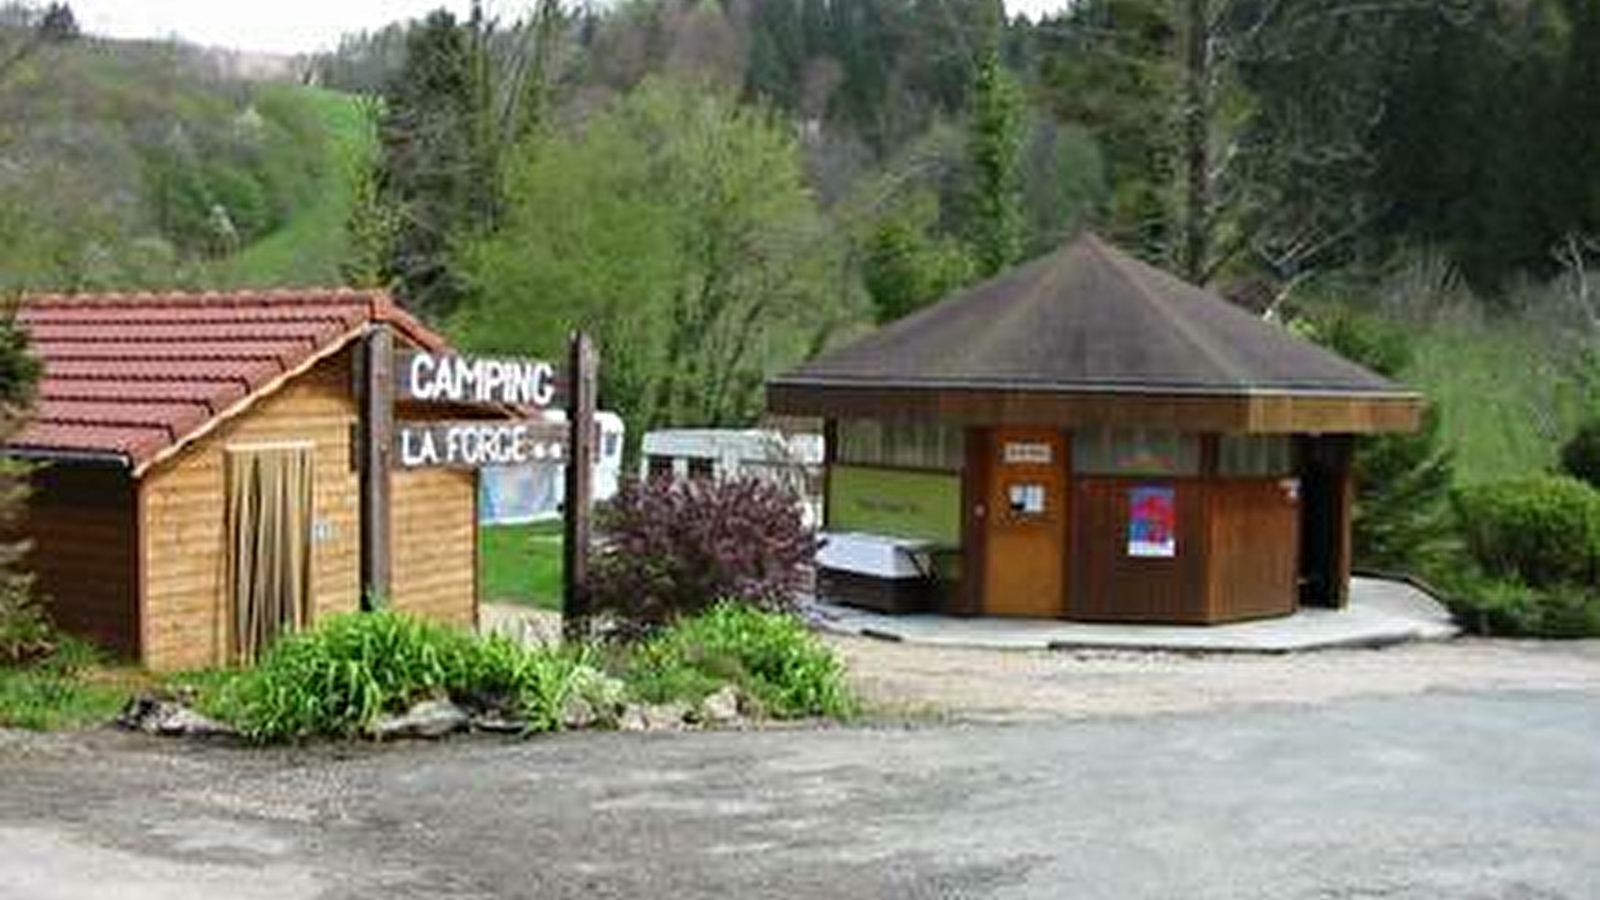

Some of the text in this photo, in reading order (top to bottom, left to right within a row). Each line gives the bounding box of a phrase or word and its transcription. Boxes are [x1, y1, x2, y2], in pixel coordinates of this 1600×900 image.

[410, 353, 555, 405] CAMPING
[401, 427, 527, 465] LA FORGE
